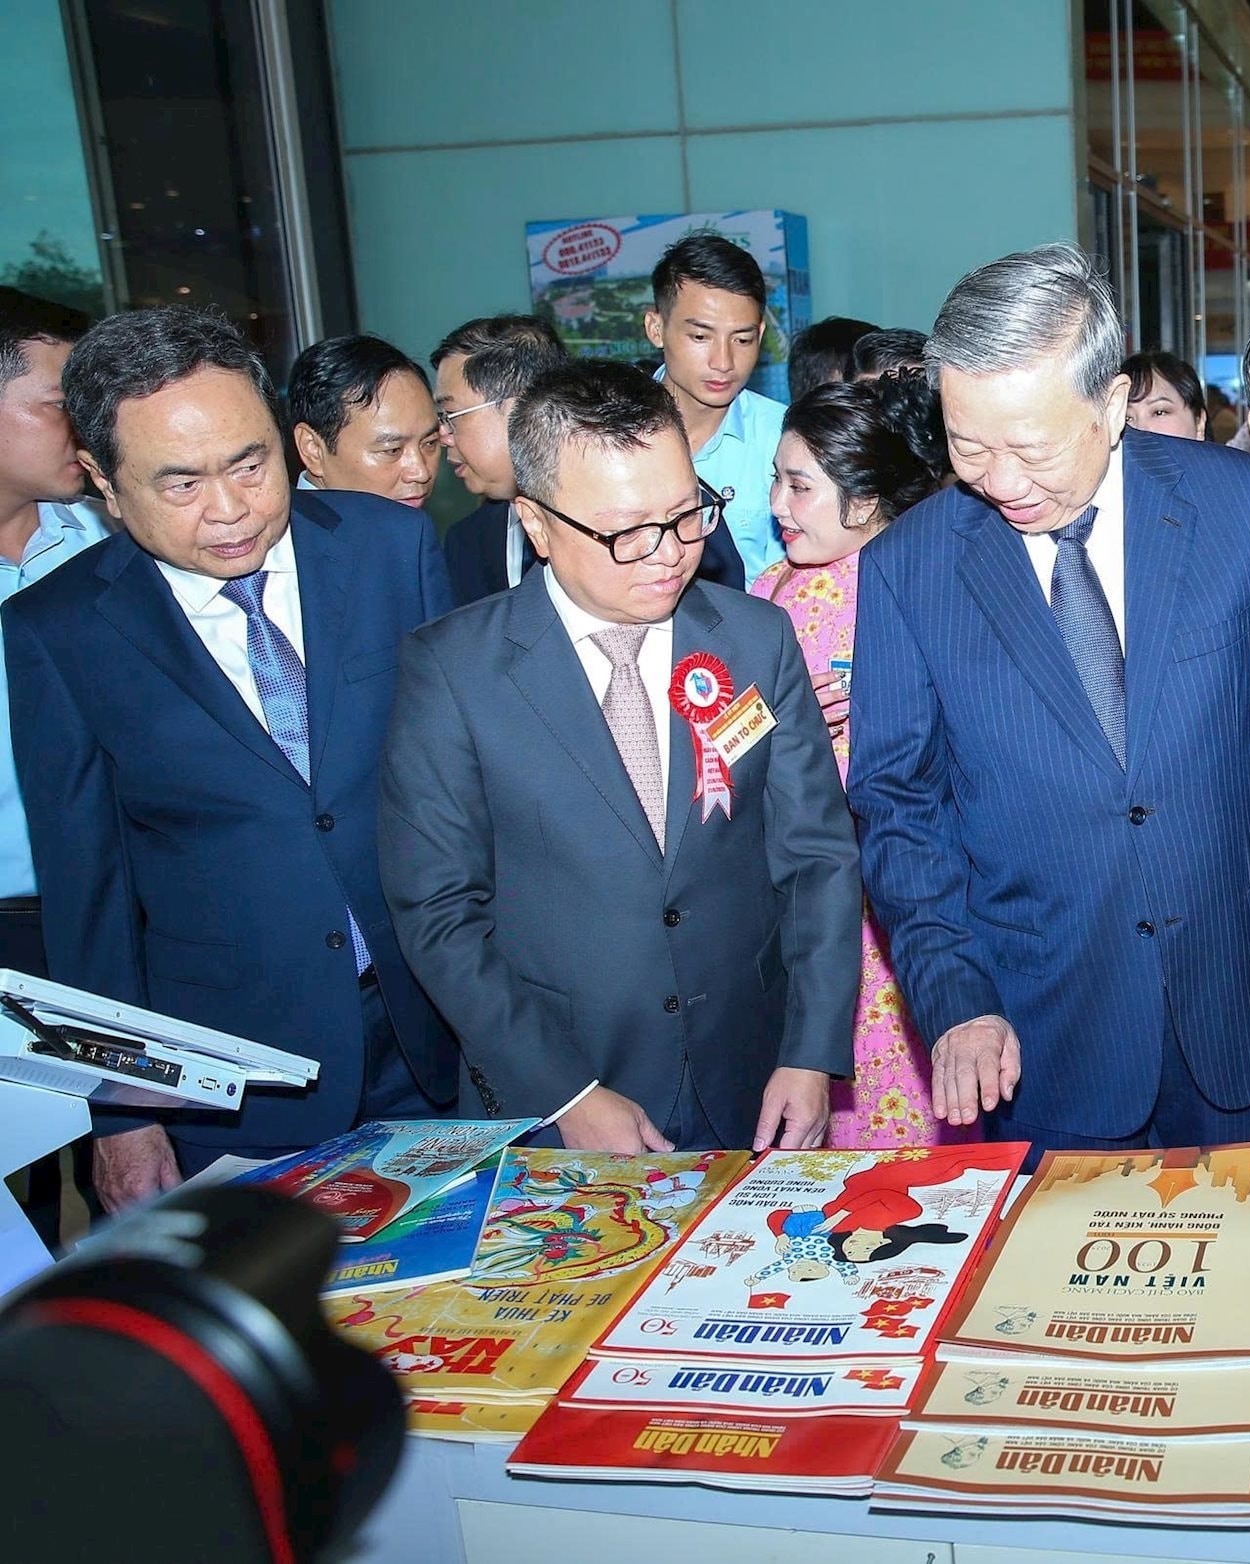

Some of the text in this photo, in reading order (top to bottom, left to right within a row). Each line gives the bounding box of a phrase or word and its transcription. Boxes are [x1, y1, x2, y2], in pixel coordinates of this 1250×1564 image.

[723, 735, 740, 754] BAN
[1093, 1210, 1129, 1220] NƯỚC
[1154, 1210, 1177, 1220] SỰ
[1180, 1210, 1224, 1220] PHỤNG
[1076, 1239, 1217, 1274] 100
[338, 1260, 399, 1281] Nhân
[1067, 1273, 1206, 1291] VIỆT NAM
[1106, 1287, 1146, 1297] CÁCH
[1147, 1288, 1174, 1297] CHÍ
[1176, 1288, 1205, 1297] BÁO
[640, 1318, 679, 1336] 50
[692, 1322, 850, 1346] Nhân Dân
[1044, 1323, 1195, 1345] Nhân Dân
[612, 1368, 657, 1386] 50
[667, 1372, 833, 1397] Nhân Dân
[1016, 1390, 1175, 1417] Nhân Dân
[633, 1430, 779, 1458] Nhân Dân
[995, 1451, 1163, 1482] Nhân Dân
